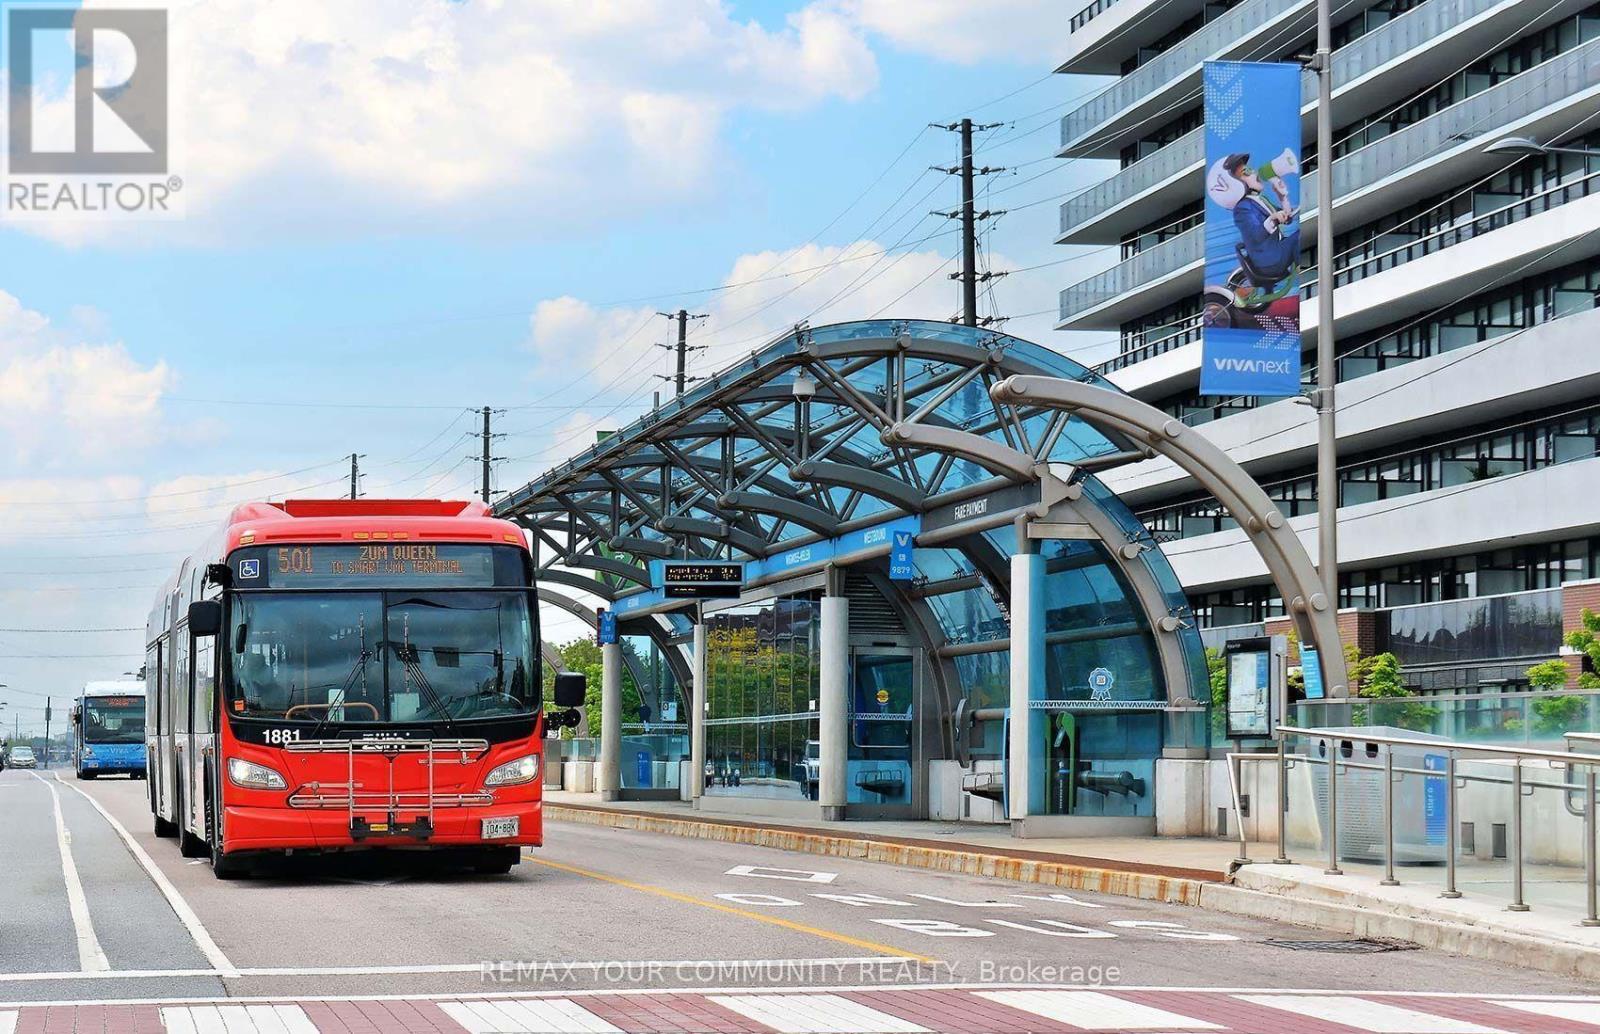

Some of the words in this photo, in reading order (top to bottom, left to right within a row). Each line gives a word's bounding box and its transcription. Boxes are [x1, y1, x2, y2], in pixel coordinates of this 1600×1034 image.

[359, 546, 388, 560] ZUM
[392, 545, 437, 560] QUEEN
[278, 547, 314, 574] 501
[411, 560, 464, 574] TERMINAL
[891, 565, 911, 575] 9879
[262, 729, 301, 744] 1881
[713, 892, 1105, 908] ONLY
[868, 917, 1243, 942] BUS
